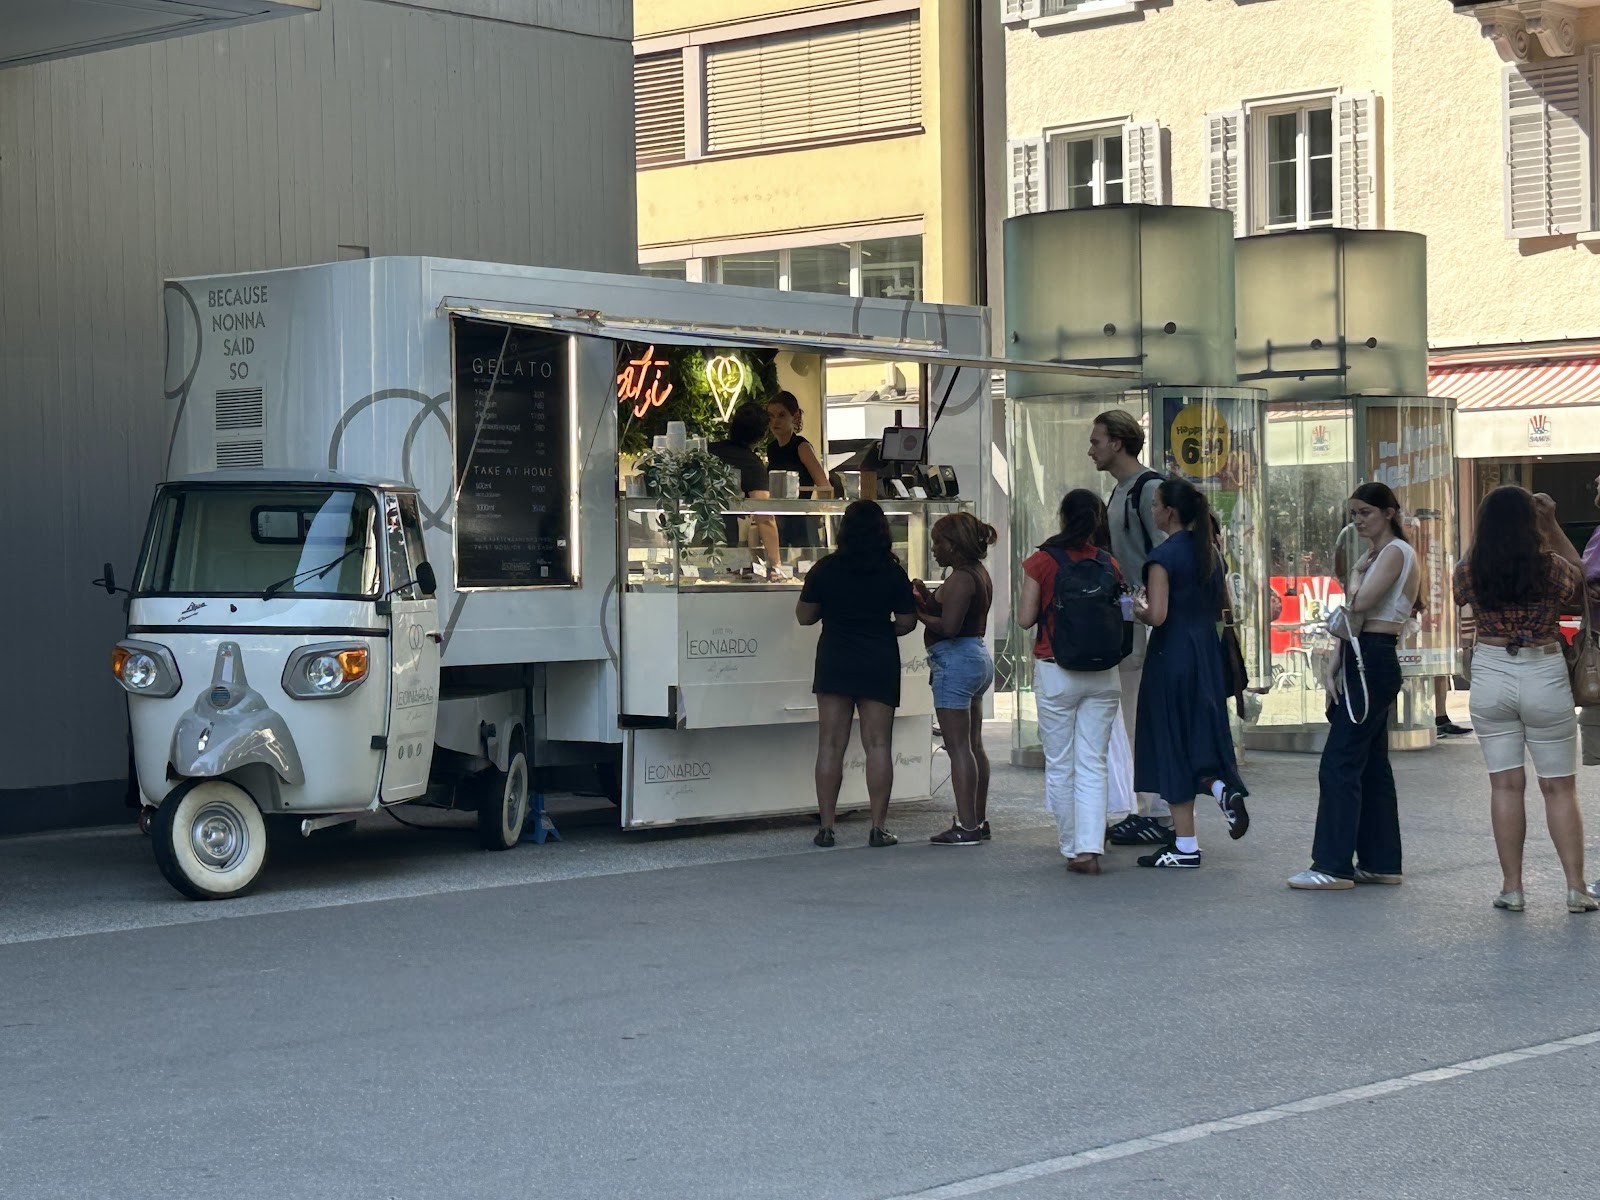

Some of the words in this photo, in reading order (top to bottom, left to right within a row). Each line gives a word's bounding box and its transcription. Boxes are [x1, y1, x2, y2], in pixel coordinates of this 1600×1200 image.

[208, 285, 268, 308] BECAUSE
[212, 311, 266, 332] NONNA
[223, 337, 255, 356] SAID
[229, 361, 249, 380] SO
[472, 358, 552, 378] GELATO
[474, 465, 501, 476] TAKE
[505, 467, 519, 476] AT
[523, 467, 553, 477] HOME
[686, 630, 758, 659] LEONARDO
[645, 757, 711, 785] LEONARDO
